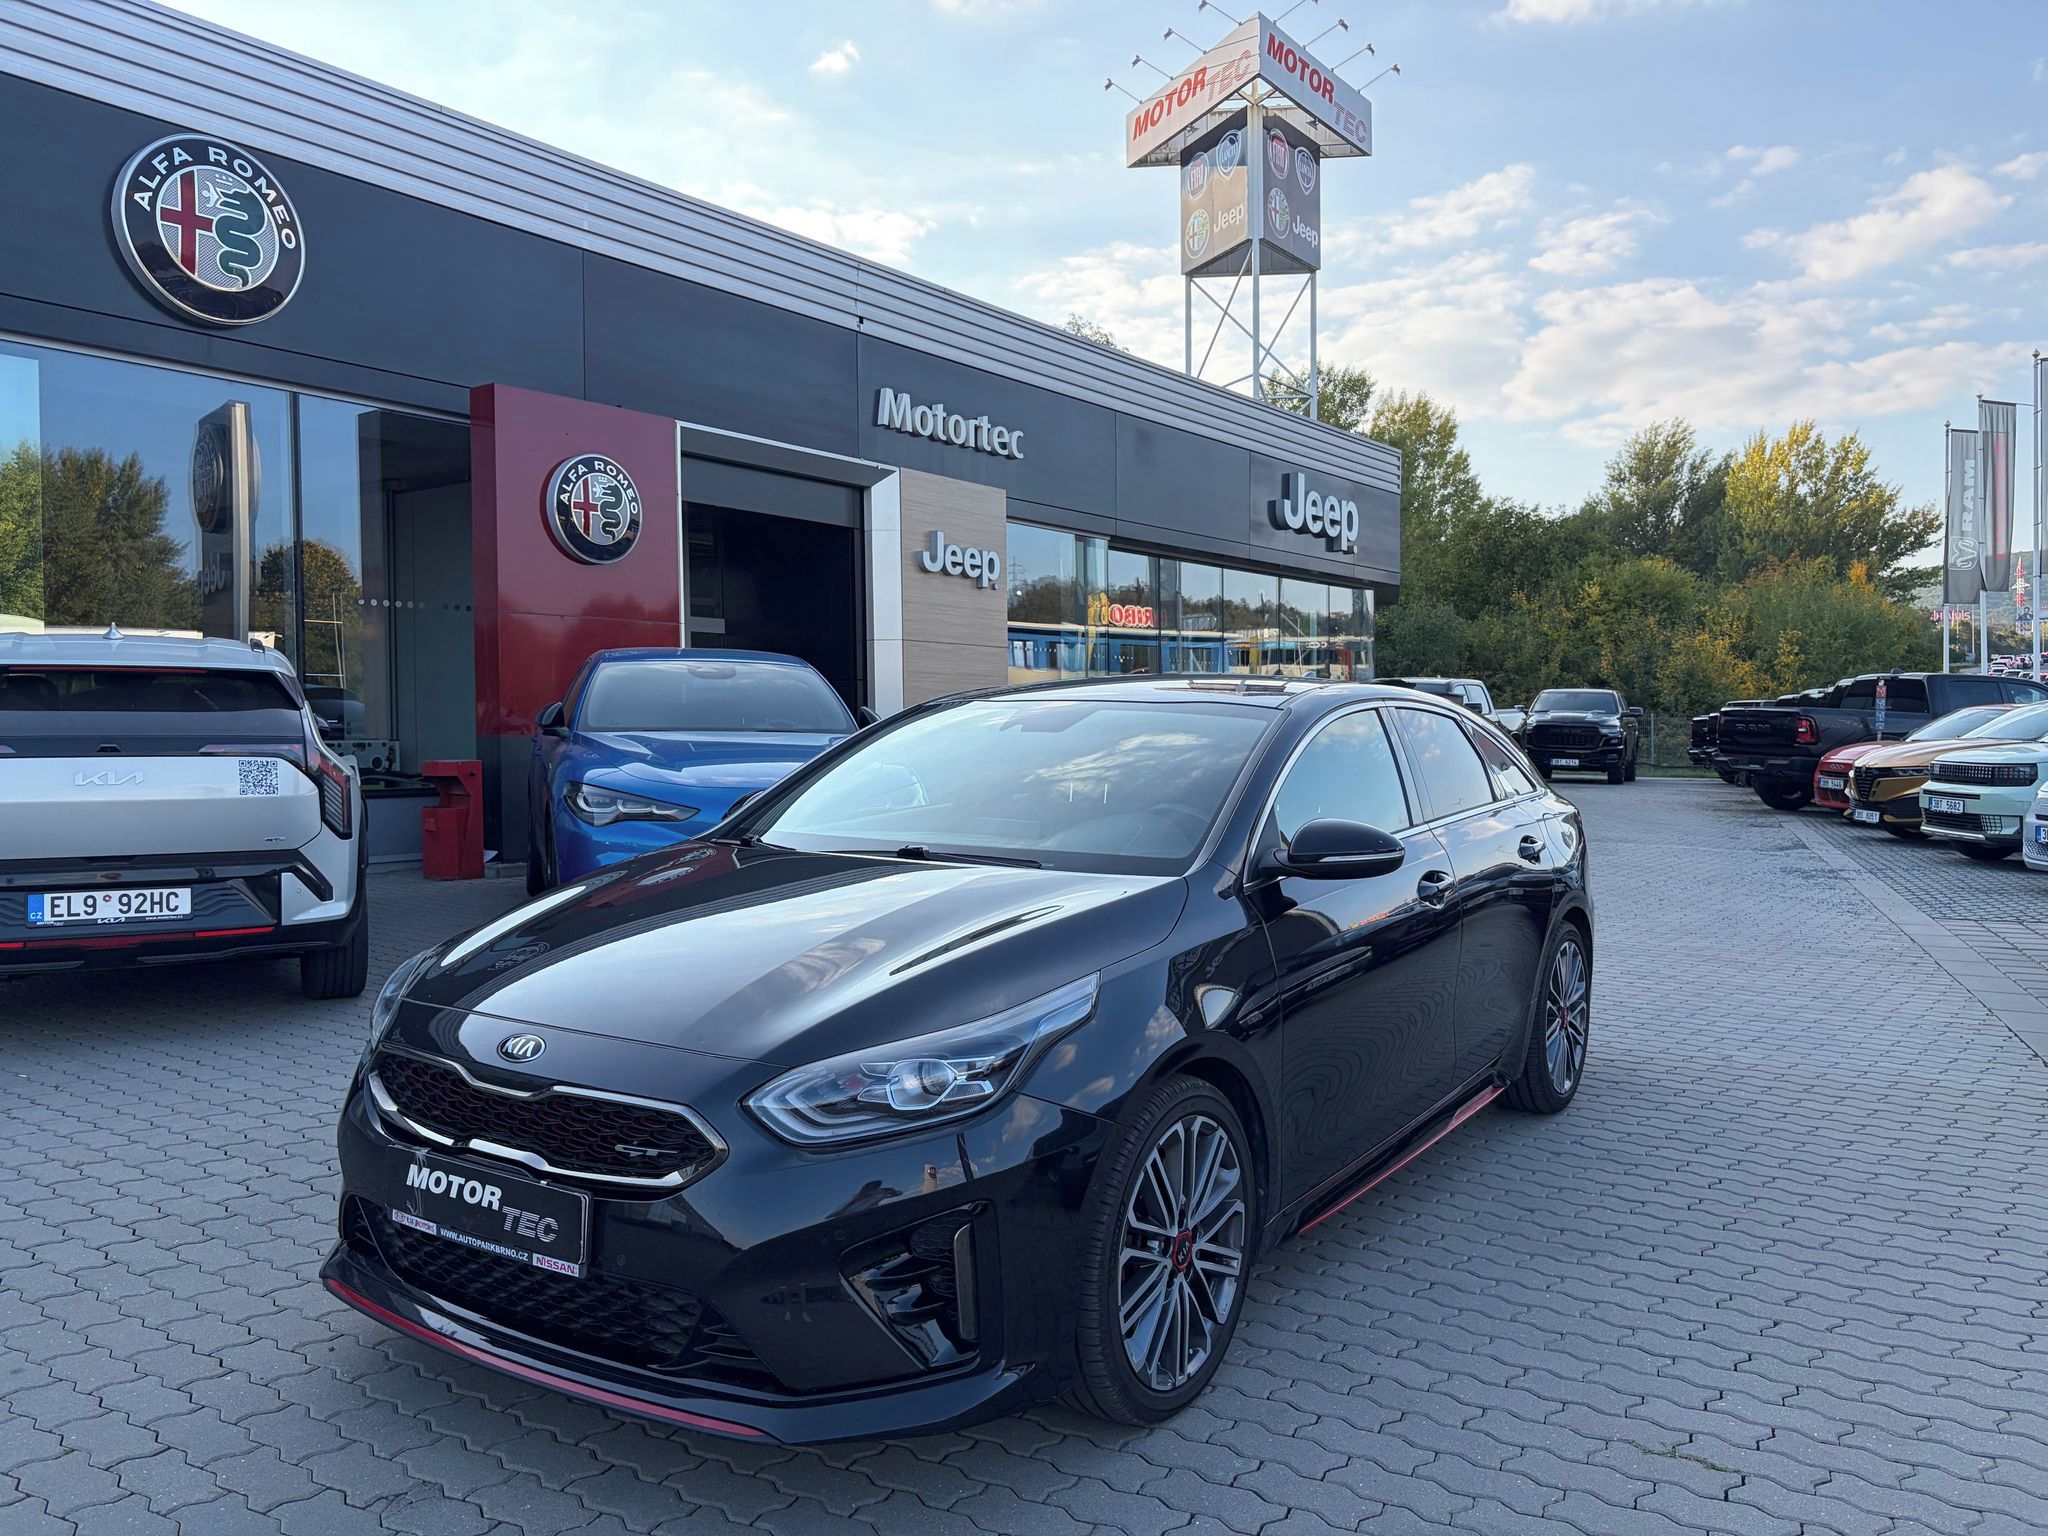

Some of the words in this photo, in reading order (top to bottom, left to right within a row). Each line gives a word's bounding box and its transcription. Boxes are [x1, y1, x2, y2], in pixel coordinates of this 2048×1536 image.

[1133, 66, 1208, 140] MOTOR
[1207, 49, 1252, 103] TEC
[1267, 32, 1336, 104] MOTOR
[1332, 101, 1368, 144] TEC
[1272, 143, 1285, 170] FIAT
[1190, 163, 1205, 190] FIAT
[133, 146, 193, 212] ALFA
[208, 146, 297, 250] ROMEO
[1213, 203, 1245, 233] Jeep
[1292, 214, 1319, 248] Jeep
[877, 387, 1024, 459] Motortec
[560, 463, 589, 505] ALFA
[594, 460, 638, 514] ROMEO
[1961, 458, 1977, 532] RAM
[1278, 472, 1359, 551] Jeep
[918, 530, 1000, 588] Jeep
[74, 770, 144, 786] KIA
[1933, 799, 1943, 809] 3BT
[1946, 800, 1961, 811] 5682
[30, 912, 43, 920] CZ
[50, 894, 98, 918] EL9
[118, 891, 180, 915] 92HC
[502, 1037, 536, 1058] KIA
[406, 1164, 502, 1211] MOTOR
[501, 1205, 560, 1243] TEC
[440, 1227, 529, 1262] WWW.AUTOPARKBRNO.CZ
[536, 1256, 575, 1275] NISSAN
